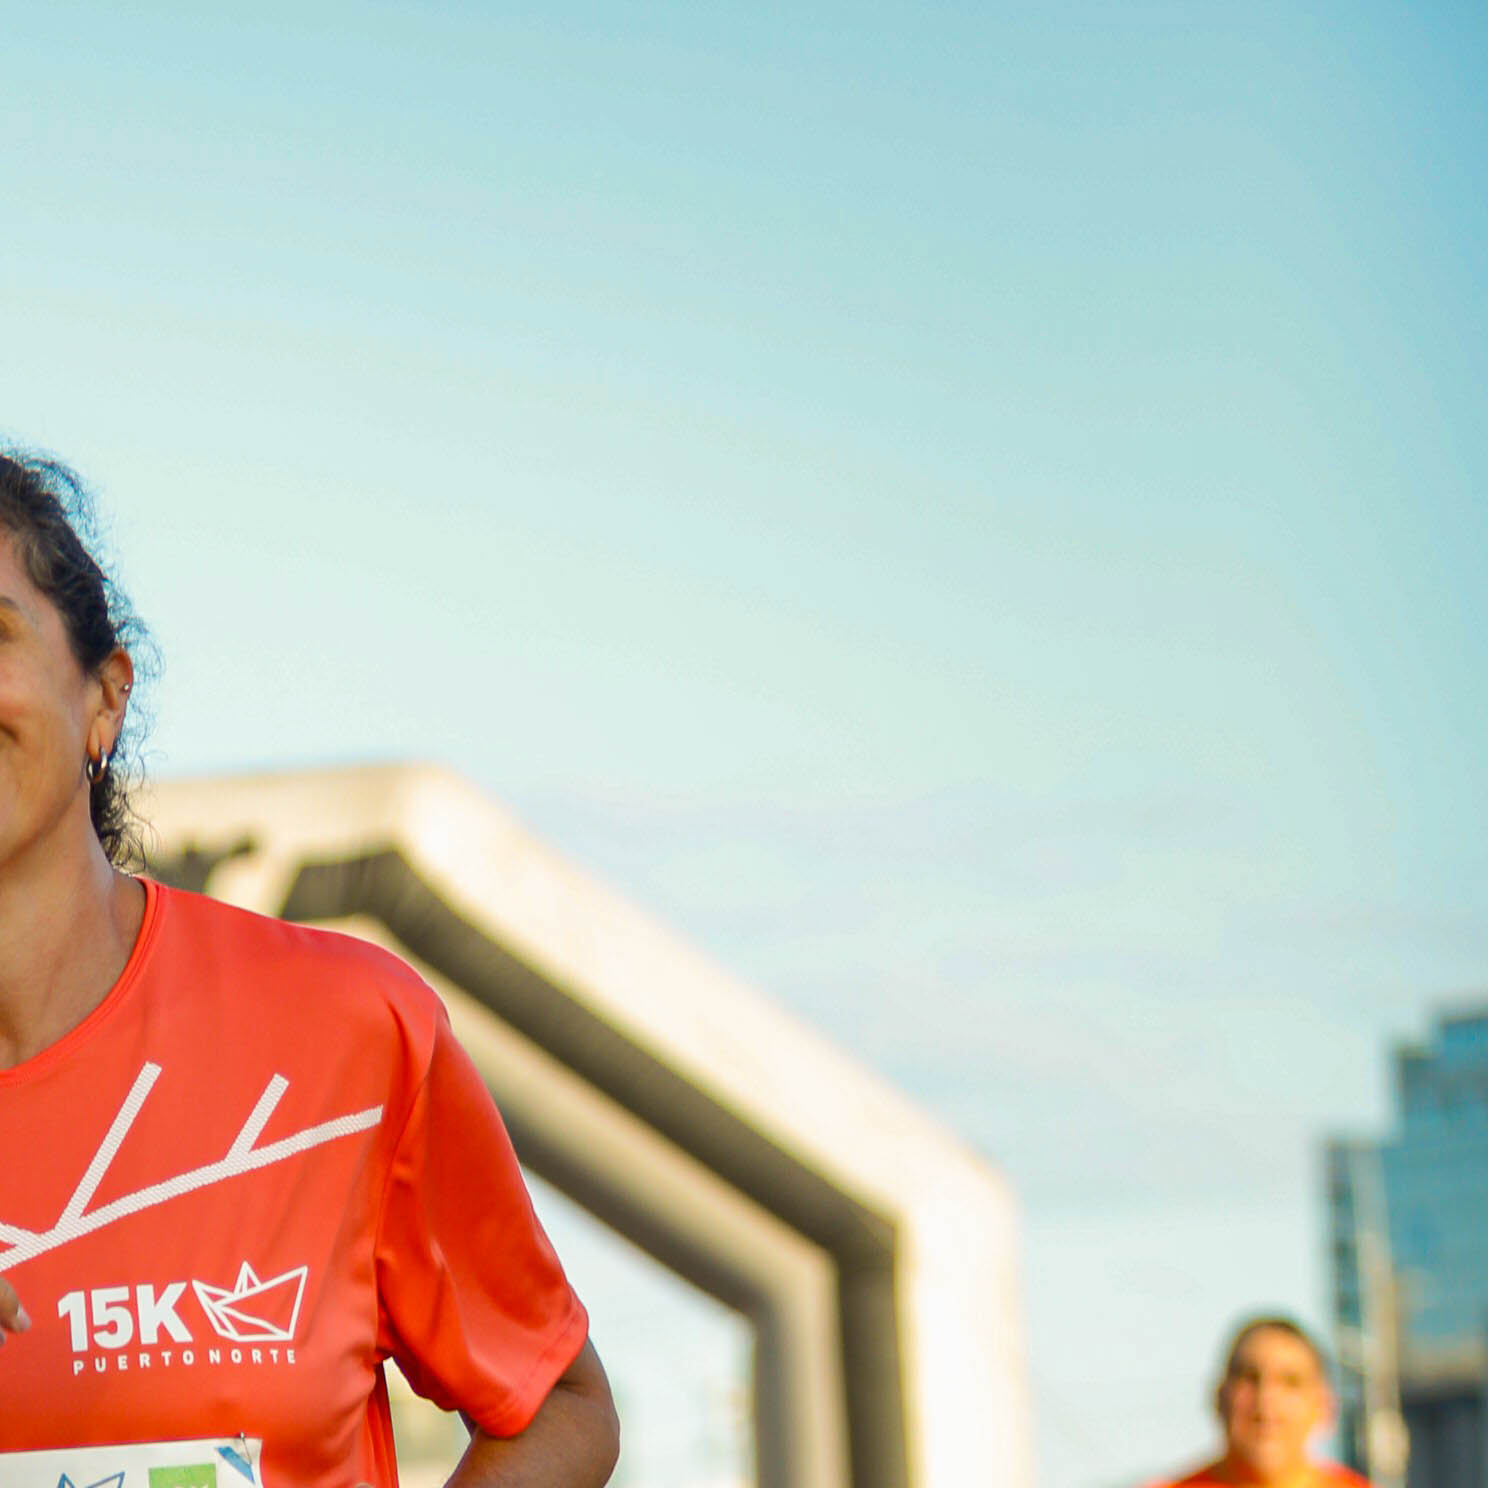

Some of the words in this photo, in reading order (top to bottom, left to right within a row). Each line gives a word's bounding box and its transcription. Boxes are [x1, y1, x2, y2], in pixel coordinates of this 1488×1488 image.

[57, 1281, 193, 1352] 15K
[73, 1349, 194, 1376] PUERTO
[208, 1349, 296, 1365] NORTE
